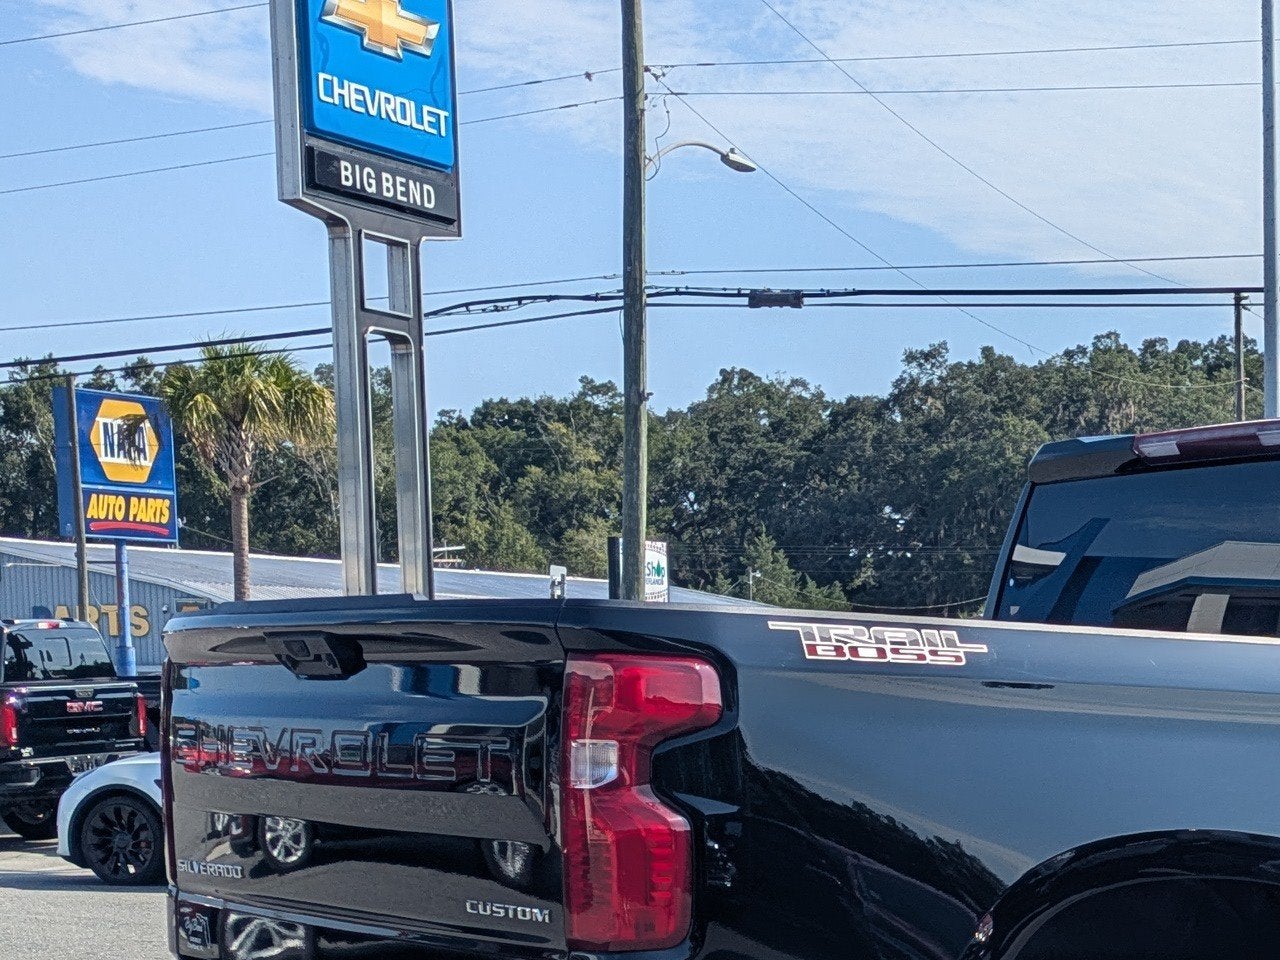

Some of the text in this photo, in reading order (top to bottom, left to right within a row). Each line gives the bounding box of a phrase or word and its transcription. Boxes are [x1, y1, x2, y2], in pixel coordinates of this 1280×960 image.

[318, 72, 449, 137] CHEVROLET
[340, 160, 436, 209] BIG BEND
[102, 421, 148, 461] NAA
[86, 493, 170, 524] AUTO PARTS
[767, 620, 988, 653] TRAIL
[804, 642, 966, 666] BOSS
[172, 723, 510, 783] CHEVROLET
[177, 859, 244, 879] SILVERADO
[465, 899, 550, 923] CUSTOM
